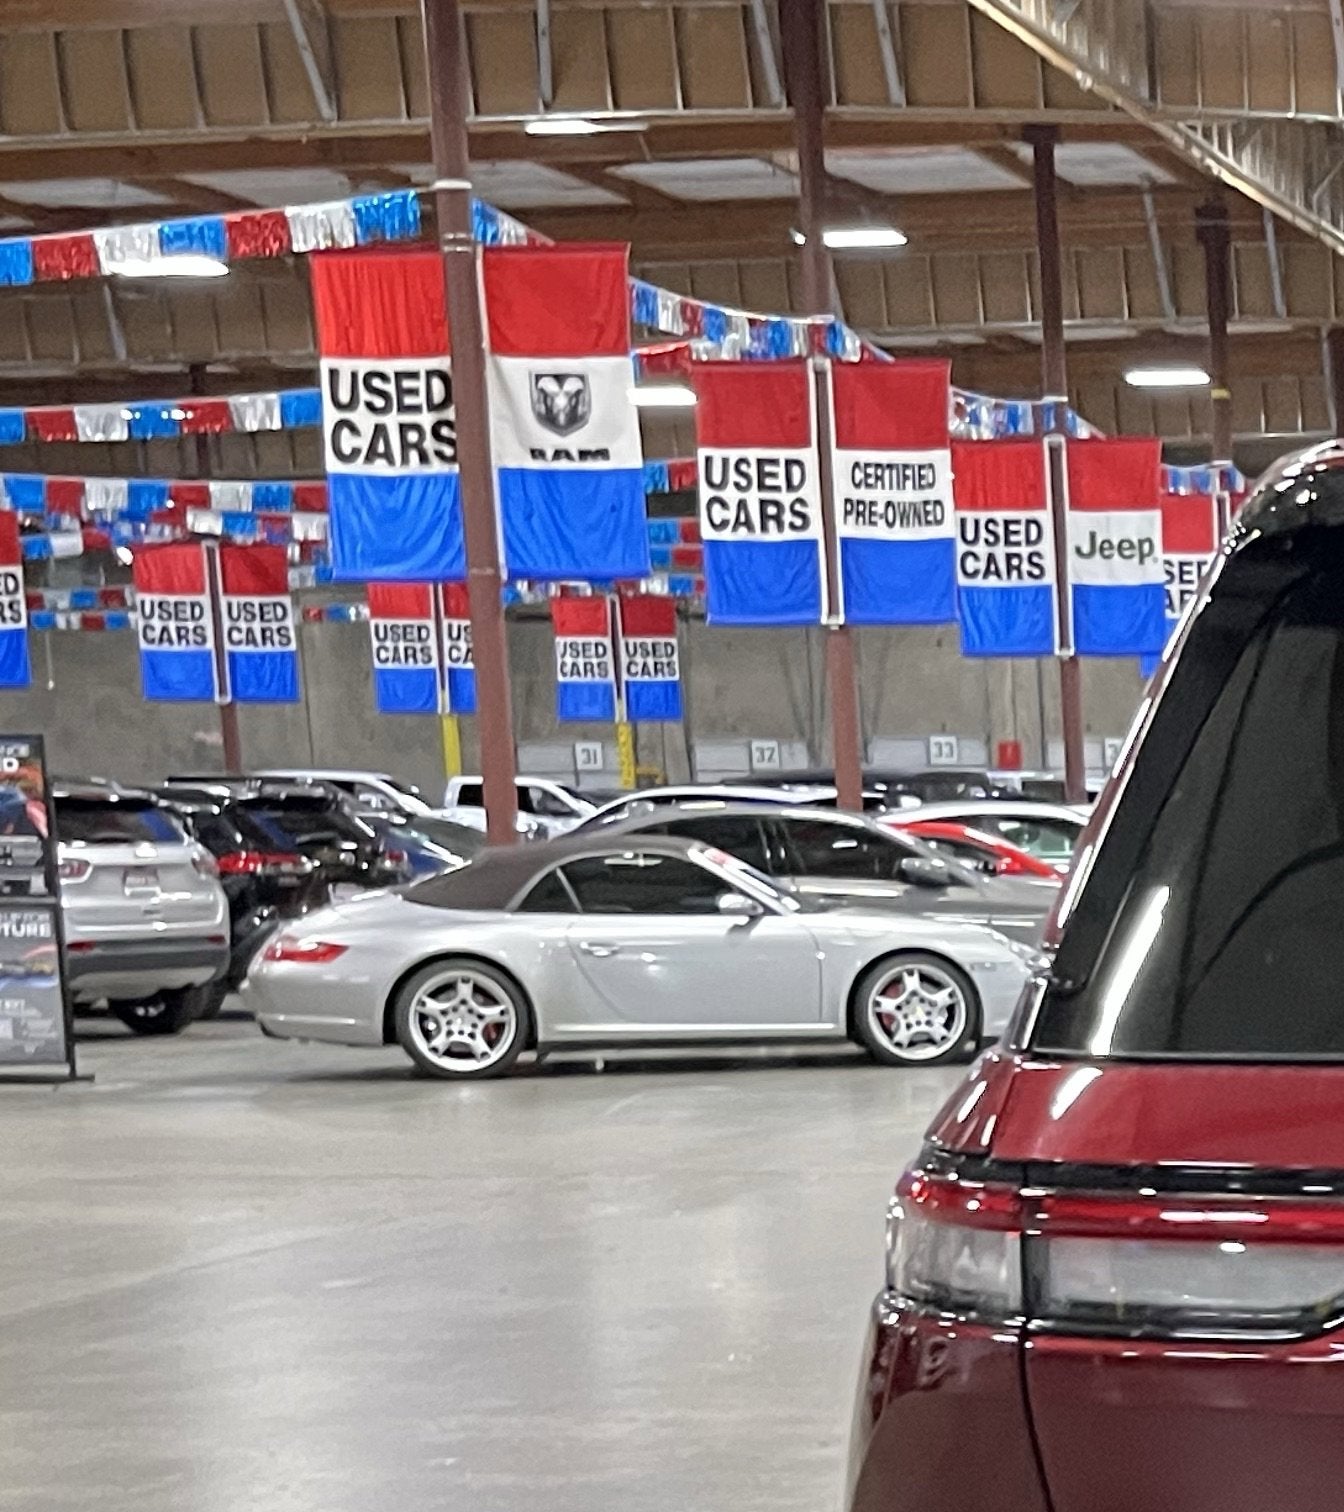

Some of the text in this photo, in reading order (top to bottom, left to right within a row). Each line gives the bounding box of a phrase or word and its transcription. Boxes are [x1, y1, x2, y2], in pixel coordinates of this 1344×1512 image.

[328, 367, 454, 416] USED
[330, 418, 458, 468] CARS
[704, 454, 807, 494] USED
[851, 461, 937, 491] CERTIFIED
[705, 495, 812, 534] CARS
[843, 497, 945, 528] PRE-OWNED
[960, 517, 1044, 548] USED
[1074, 530, 1156, 566] Jeep
[960, 550, 1047, 581] CARS
[140, 599, 205, 623] USED
[227, 601, 288, 624] USED
[142, 624, 208, 647] CARS
[227, 625, 293, 648] CARS
[374, 623, 431, 643] USED
[376, 645, 433, 665] CARS
[625, 641, 675, 660] USED
[560, 661, 609, 679] CARS
[626, 661, 677, 679] CARS
